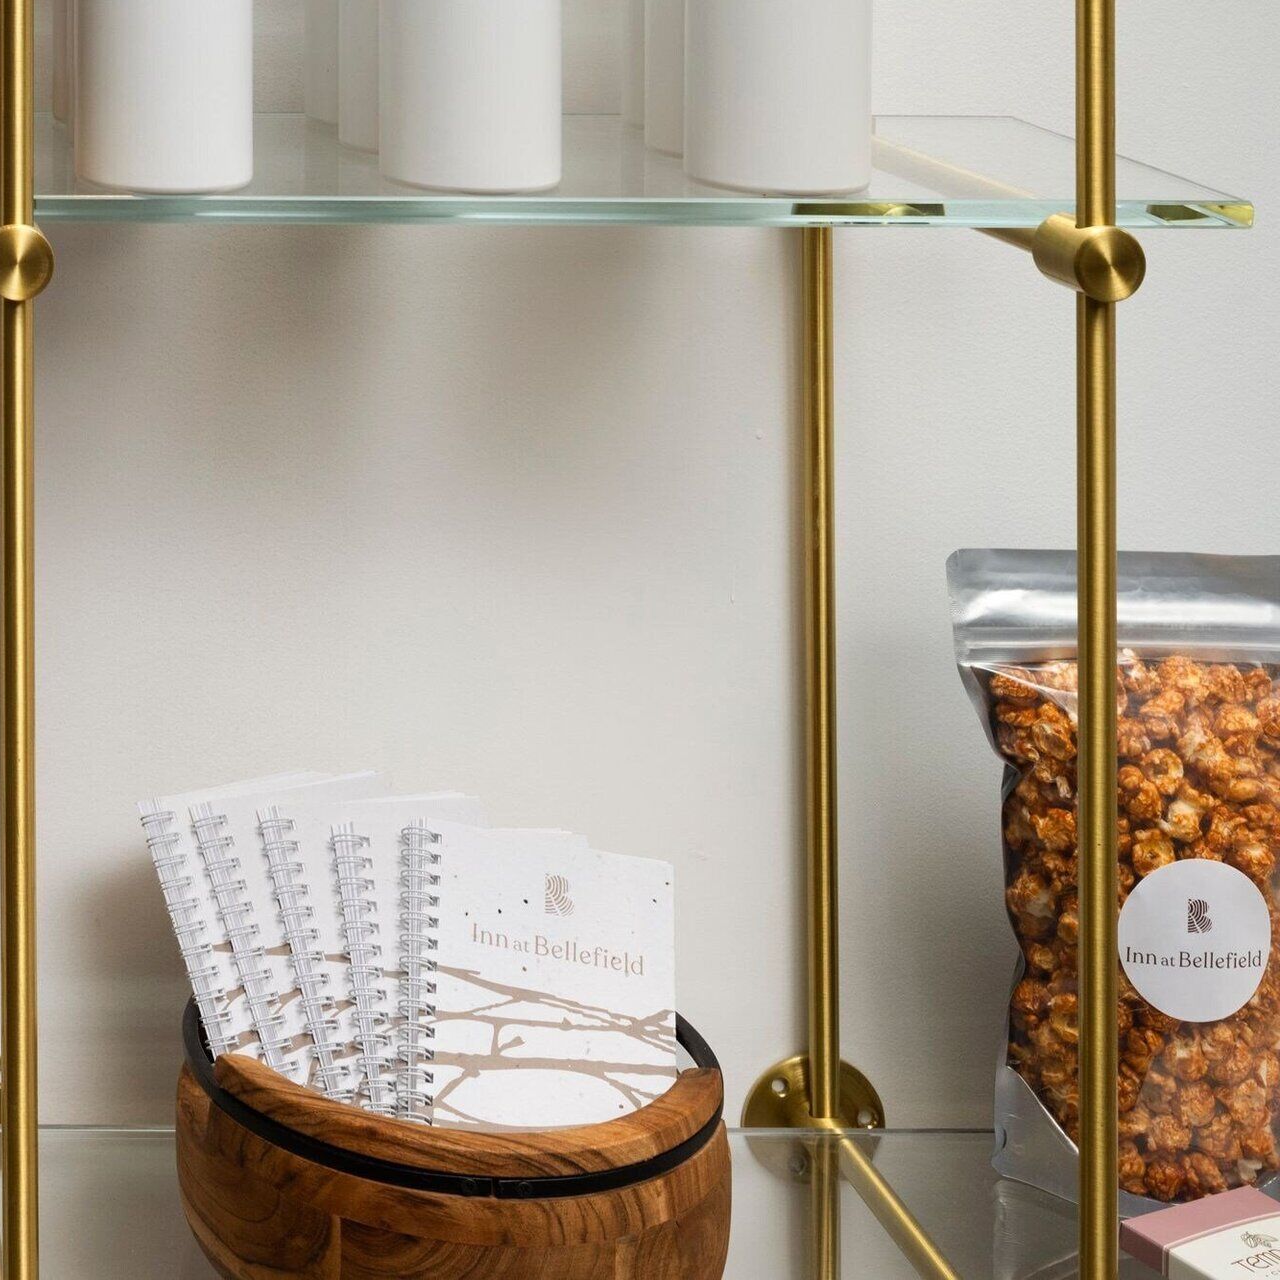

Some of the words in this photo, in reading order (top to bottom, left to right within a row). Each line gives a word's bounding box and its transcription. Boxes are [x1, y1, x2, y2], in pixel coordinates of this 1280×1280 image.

[472, 923, 508, 948] Inn
[513, 939, 529, 953] at
[534, 935, 645, 976] Bellefield
[1126, 947, 1157, 965] Inn
[1161, 956, 1175, 967] at
[1179, 950, 1262, 968] Bellefield
[1231, 1249, 1280, 1273] Tem
